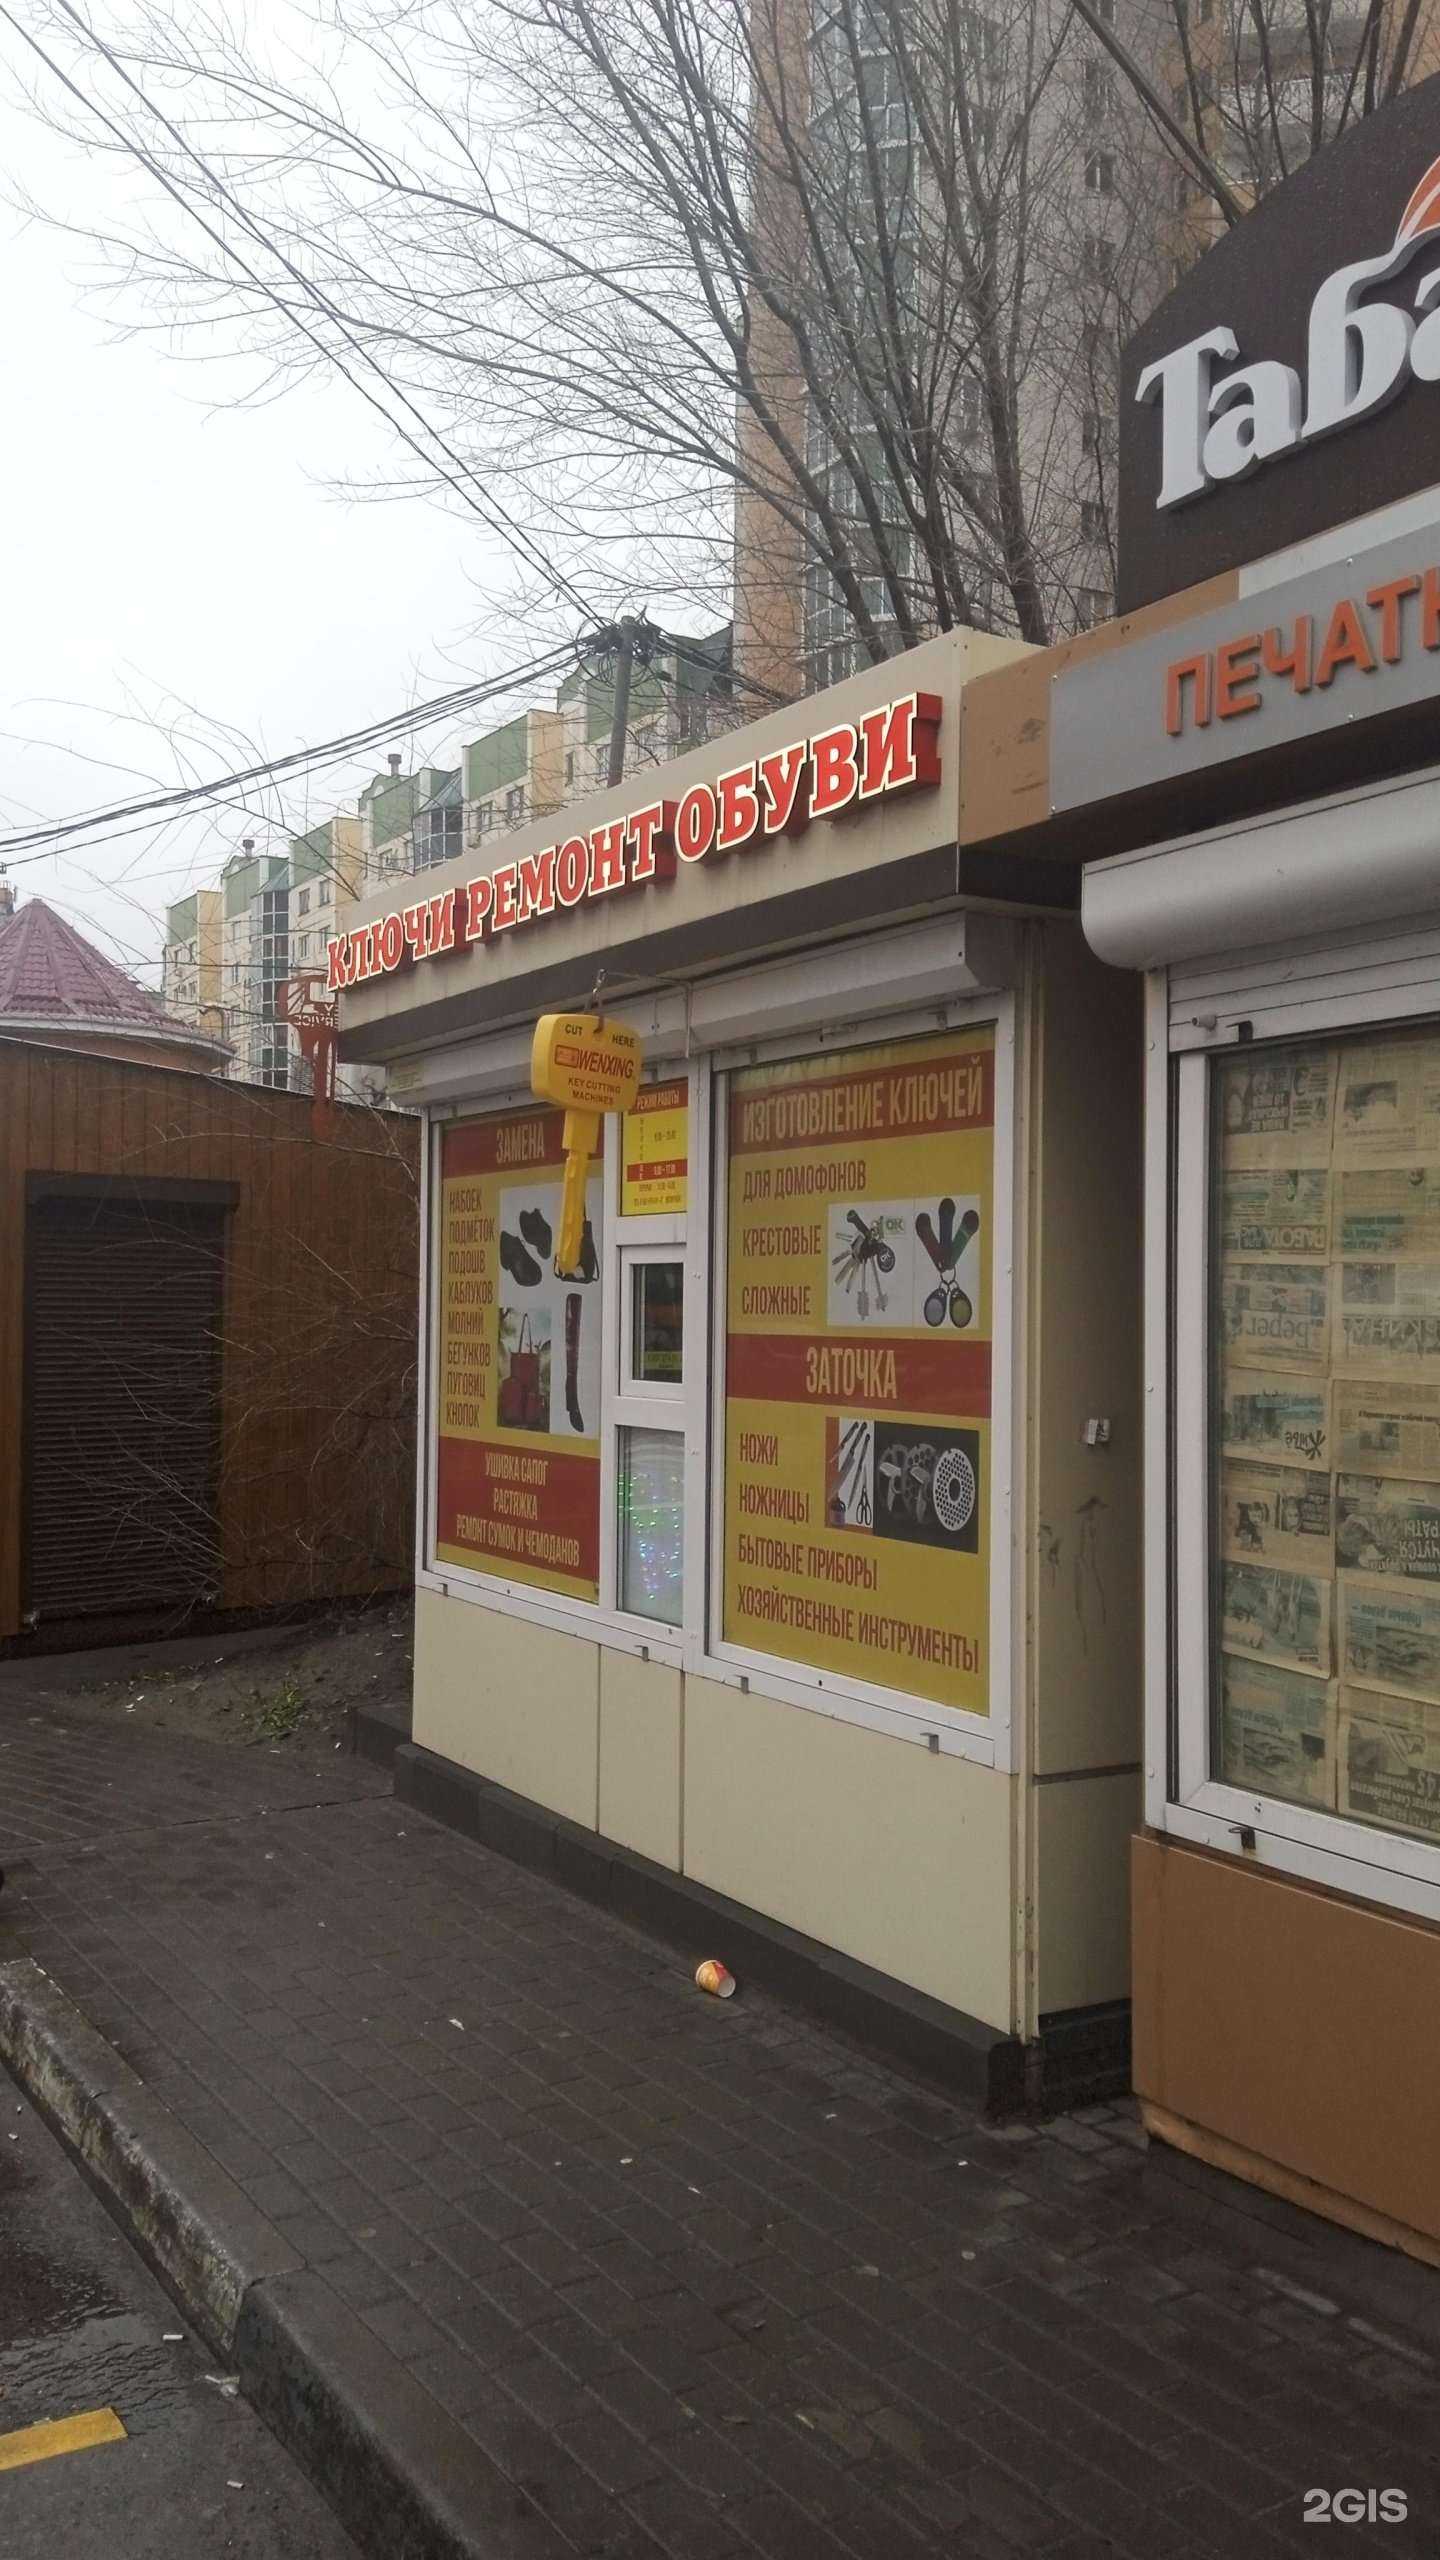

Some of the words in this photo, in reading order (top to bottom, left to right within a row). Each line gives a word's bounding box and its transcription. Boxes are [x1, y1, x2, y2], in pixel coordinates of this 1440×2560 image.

[326, 888, 458, 993] КЛЮЧИ
[465, 800, 670, 942] РЕМОНТ
[674, 692, 920, 863] ОБУВИ
[564, 1023, 584, 1037] CUT
[611, 1034, 636, 1049] HERE
[577, 1048, 634, 1080] WENXING
[567, 1077, 585, 1089] KEY
[586, 1082, 622, 1096] CUTTING
[743, 1080, 884, 1143] ИЗГОТОВЛЕНИЕ
[889, 1055, 983, 1125] КЛЮЧЕЙ
[496, 1121, 546, 1165] ЗАМЕНА
[743, 1170, 770, 1202] ДЛЯ
[775, 1160, 866, 1200] ДОМОФОНОВ
[449, 1188, 482, 1213] НАБОЕК
[448, 1217, 496, 1244] ПОДМЕТОК
[743, 1224, 822, 1256] КРЕСТОВЫЕ
[448, 1250, 486, 1275] ПОДОШВ
[448, 1280, 494, 1306] КАБЛУКОВ
[742, 1286, 811, 1316] СЛОЖНЫЕ
[448, 1306, 484, 1336] МОЛНИЙ
[447, 1342, 491, 1367] БЕГУНКОВ
[447, 1371, 486, 1398] ПУГОВИЦ
[806, 1346, 897, 1399] ЗАТОЧКА
[446, 1402, 480, 1428] КНОПОК
[740, 1433, 778, 1465] НОЖИ
[485, 1453, 520, 1479] УШИВКА
[521, 1459, 548, 1486] САПОГ
[494, 1488, 538, 1520] РАСТЯЖКА
[739, 1486, 809, 1523] НОЖНИЦЫ
[456, 1514, 488, 1542] РЕМОНТ
[489, 1521, 516, 1550] СУМОК
[517, 1529, 523, 1552] И
[525, 1531, 580, 1567] ЧЕМОДАНОВ
[738, 1534, 804, 1575] БЫТОВЫЕ
[807, 1547, 877, 1591] ПРИБОРЫ
[737, 1583, 854, 1642] ХОЗЯЙСТВЕННЫЕ
[858, 1615, 979, 1674] ИНСТРУМЕНТЫ
